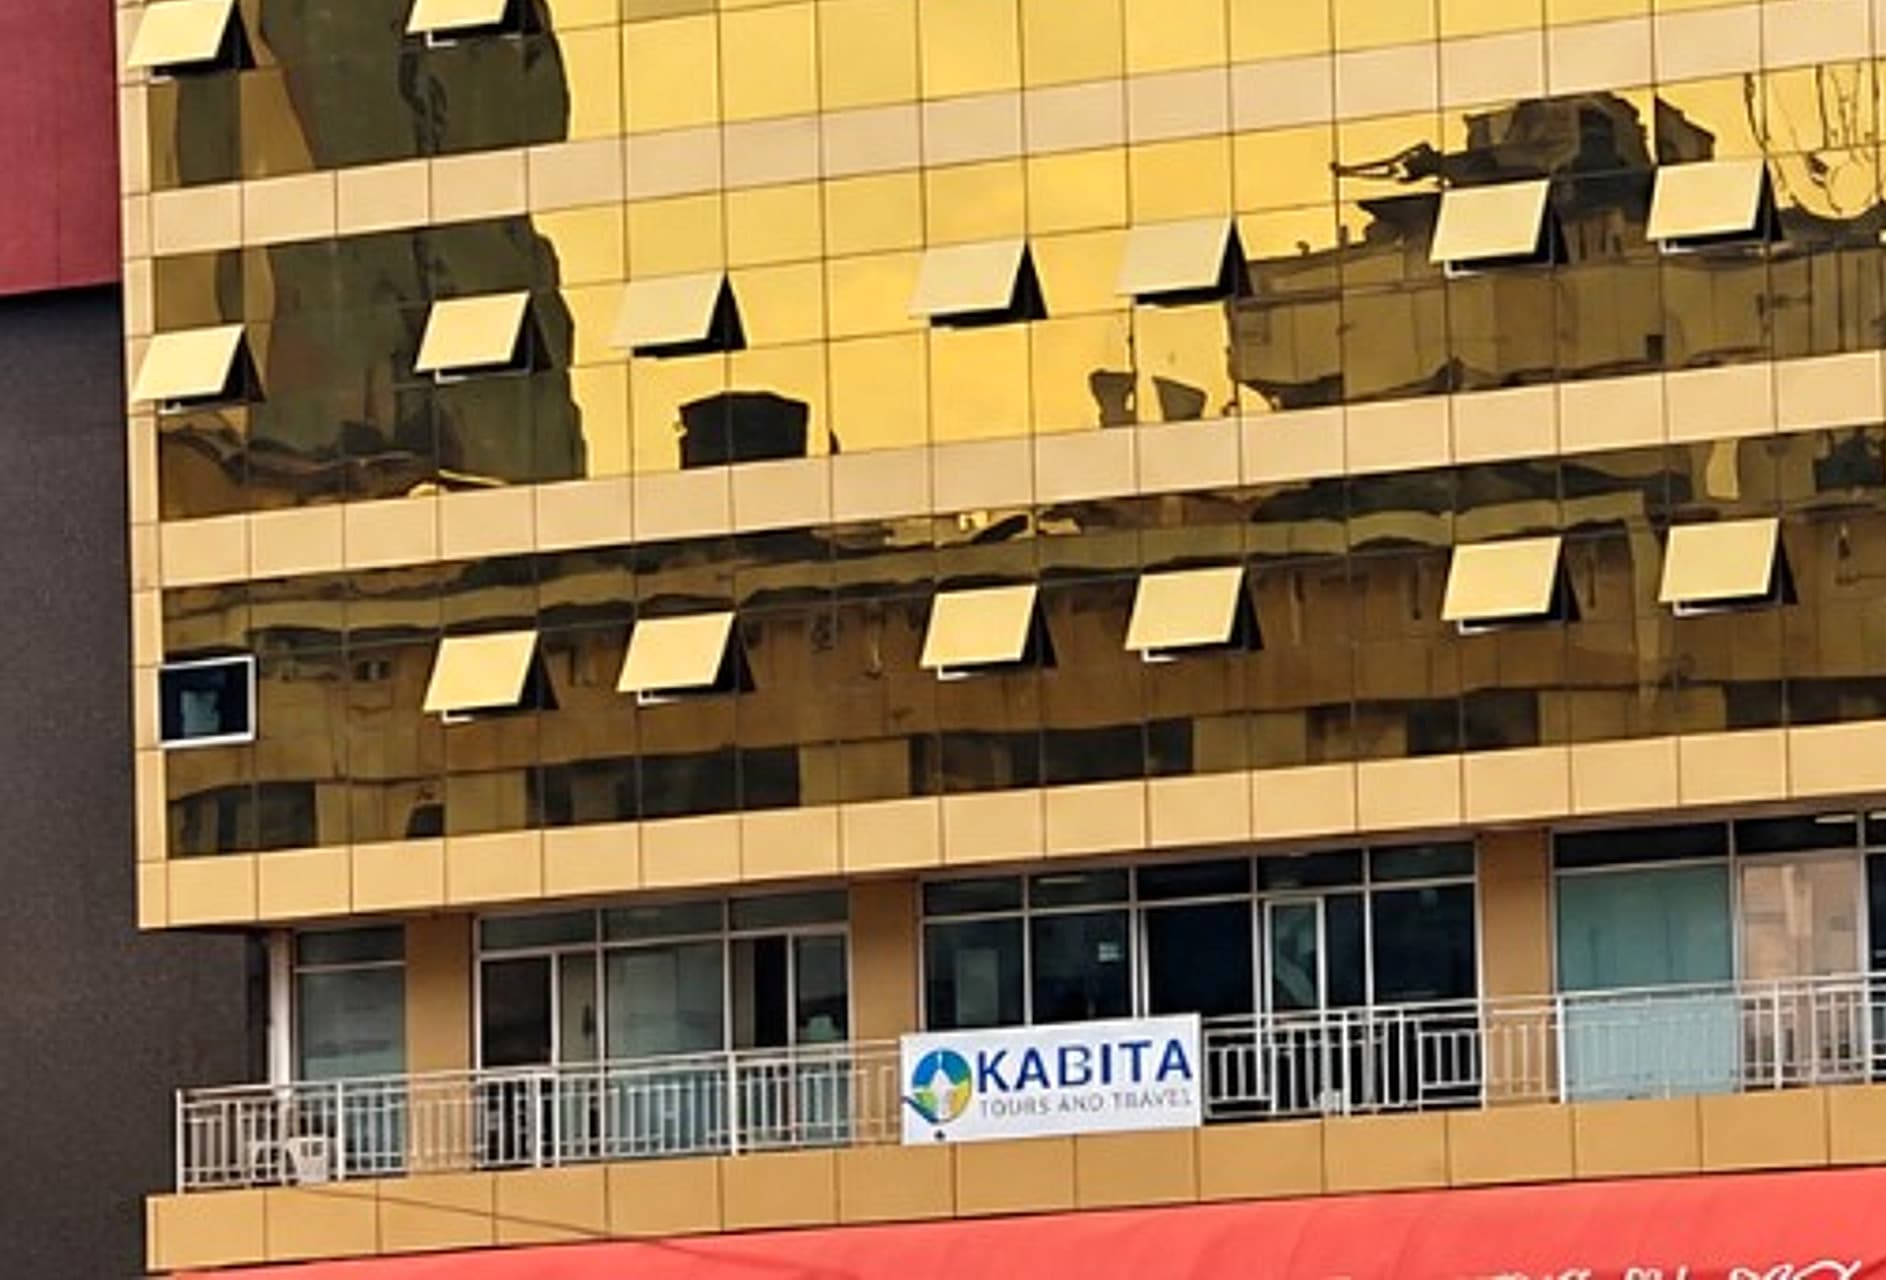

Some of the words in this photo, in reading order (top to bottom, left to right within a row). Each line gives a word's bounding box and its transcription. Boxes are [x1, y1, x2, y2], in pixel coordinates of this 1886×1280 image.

[976, 1038, 1193, 1093] KABITA
[979, 1096, 1049, 1119] TOURS
[1057, 1092, 1104, 1113] AND
[1112, 1086, 1193, 1110] TRAVEL
